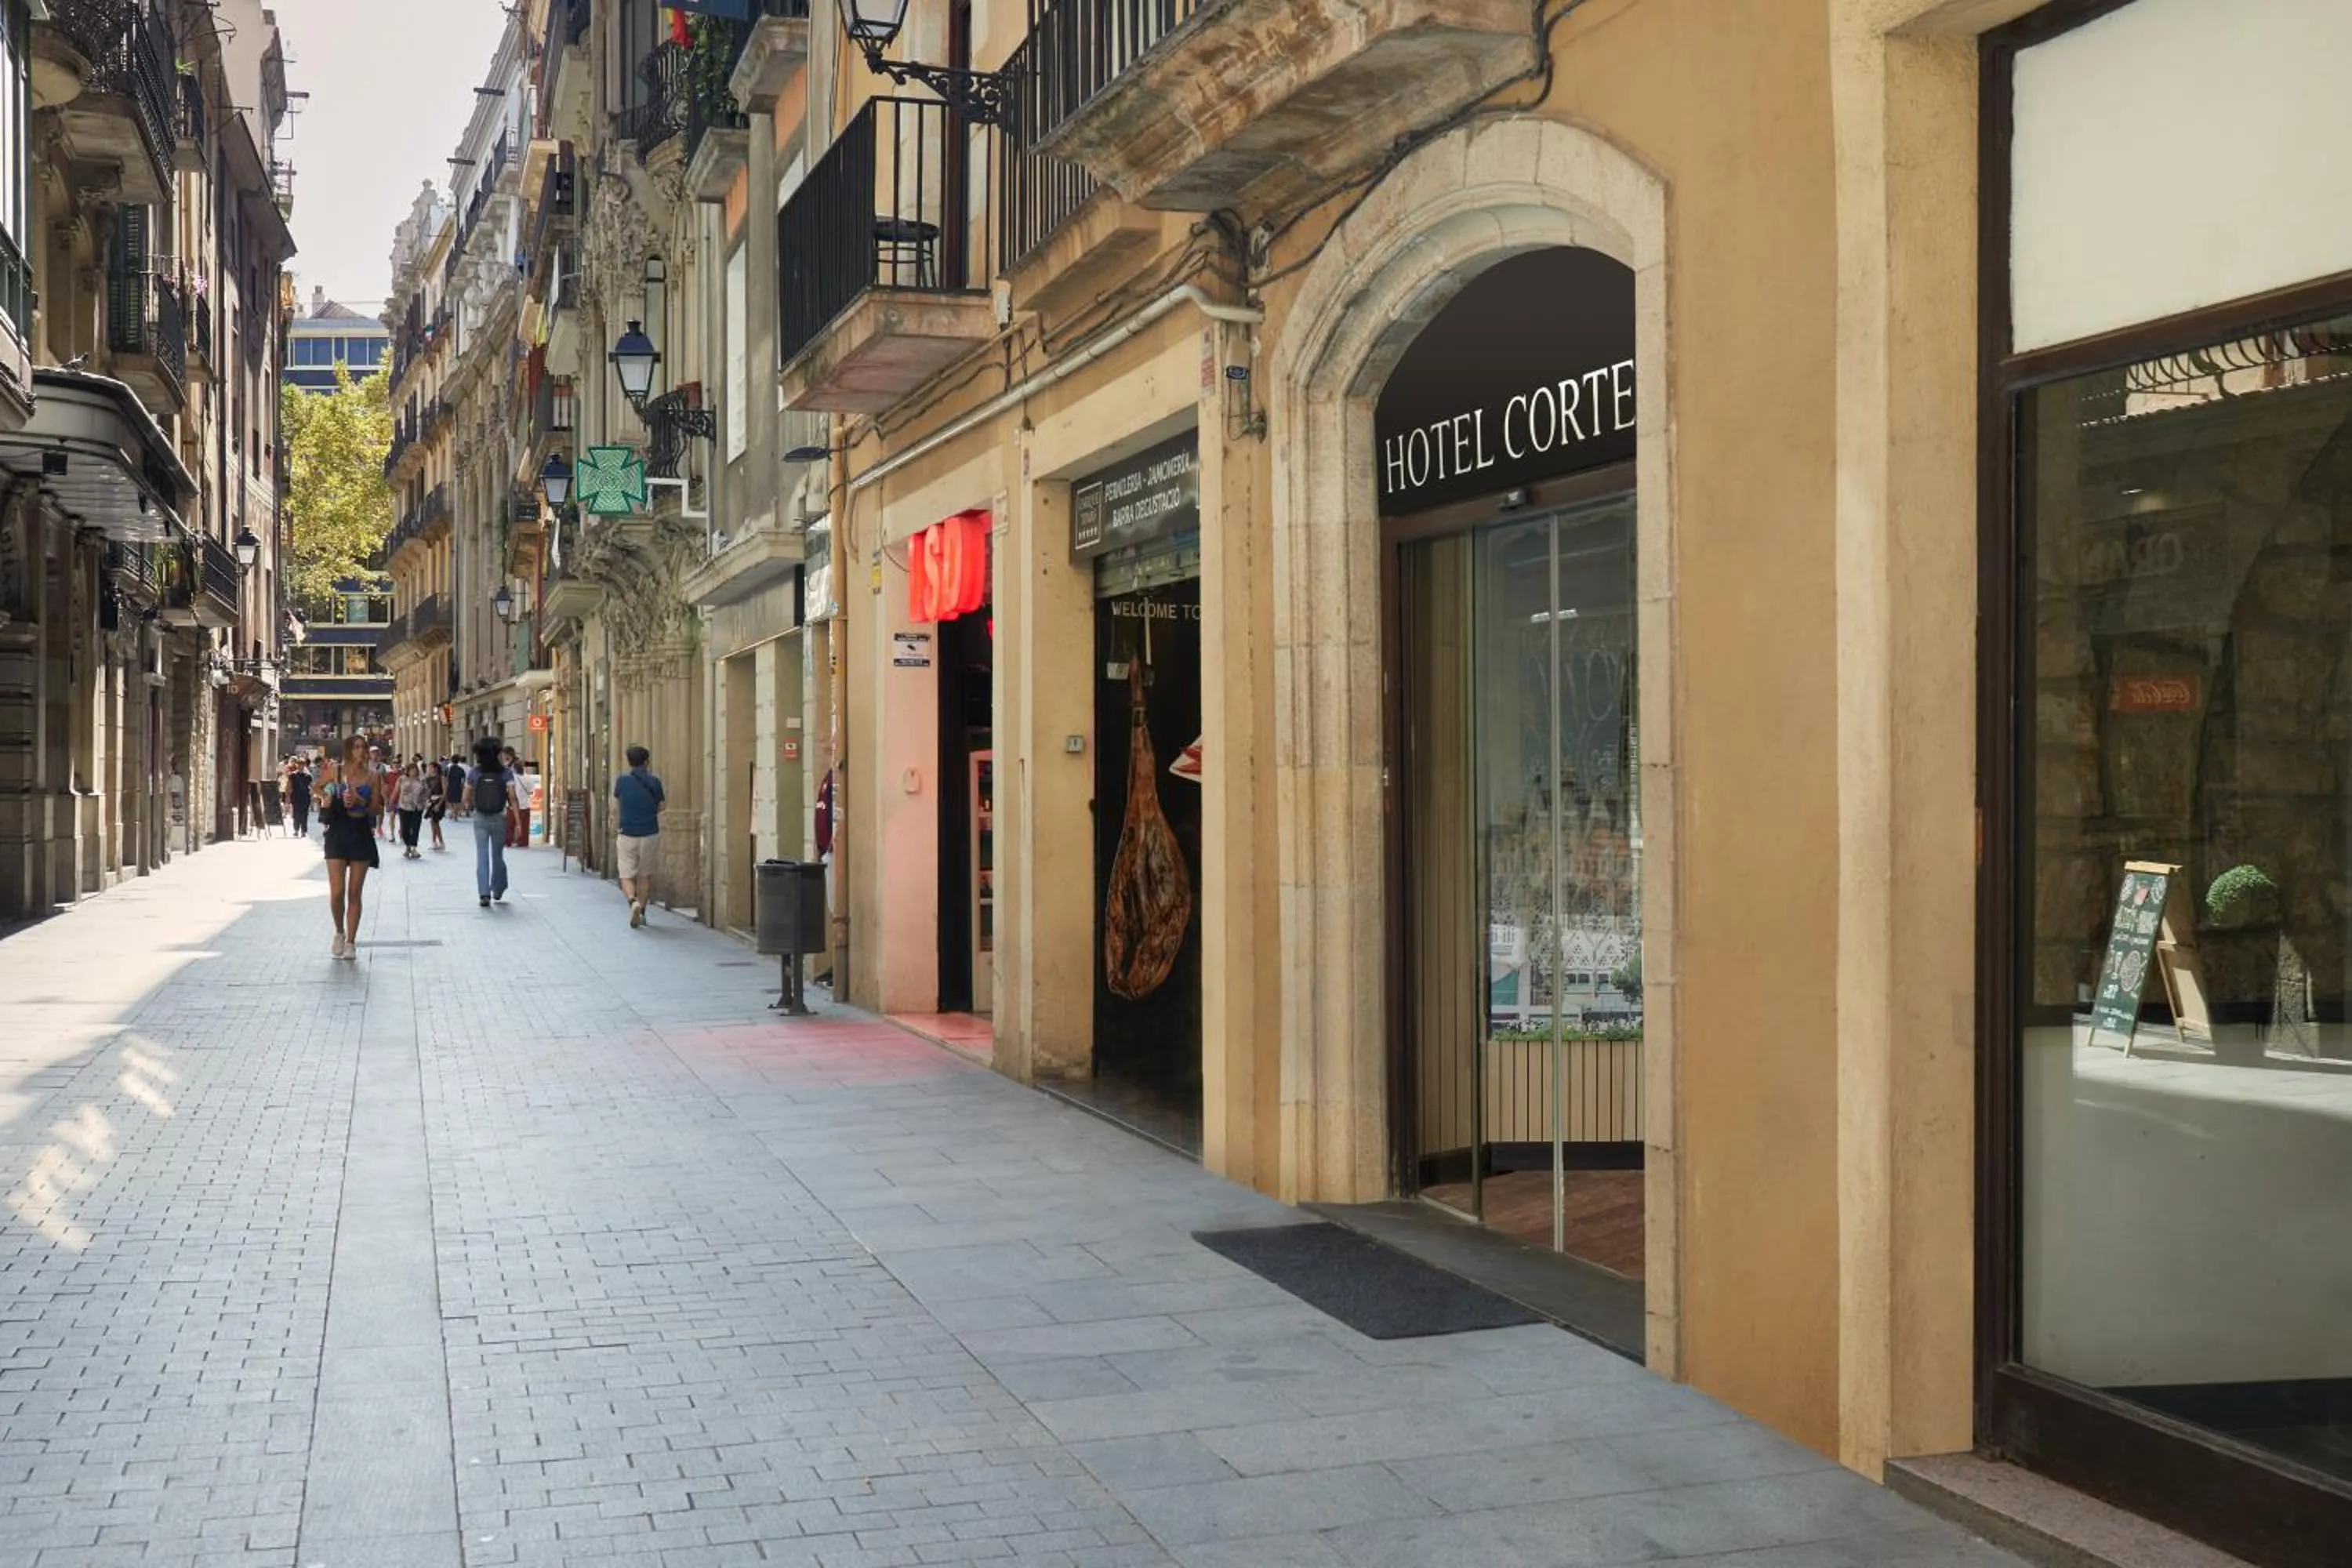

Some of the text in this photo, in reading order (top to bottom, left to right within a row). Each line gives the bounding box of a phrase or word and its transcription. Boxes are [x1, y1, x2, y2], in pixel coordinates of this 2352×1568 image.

[1385, 358, 1636, 494] HOTEL CORTE
[1112, 503, 1134, 528] BARRA
[1111, 601, 1201, 620] WELCOME TO
